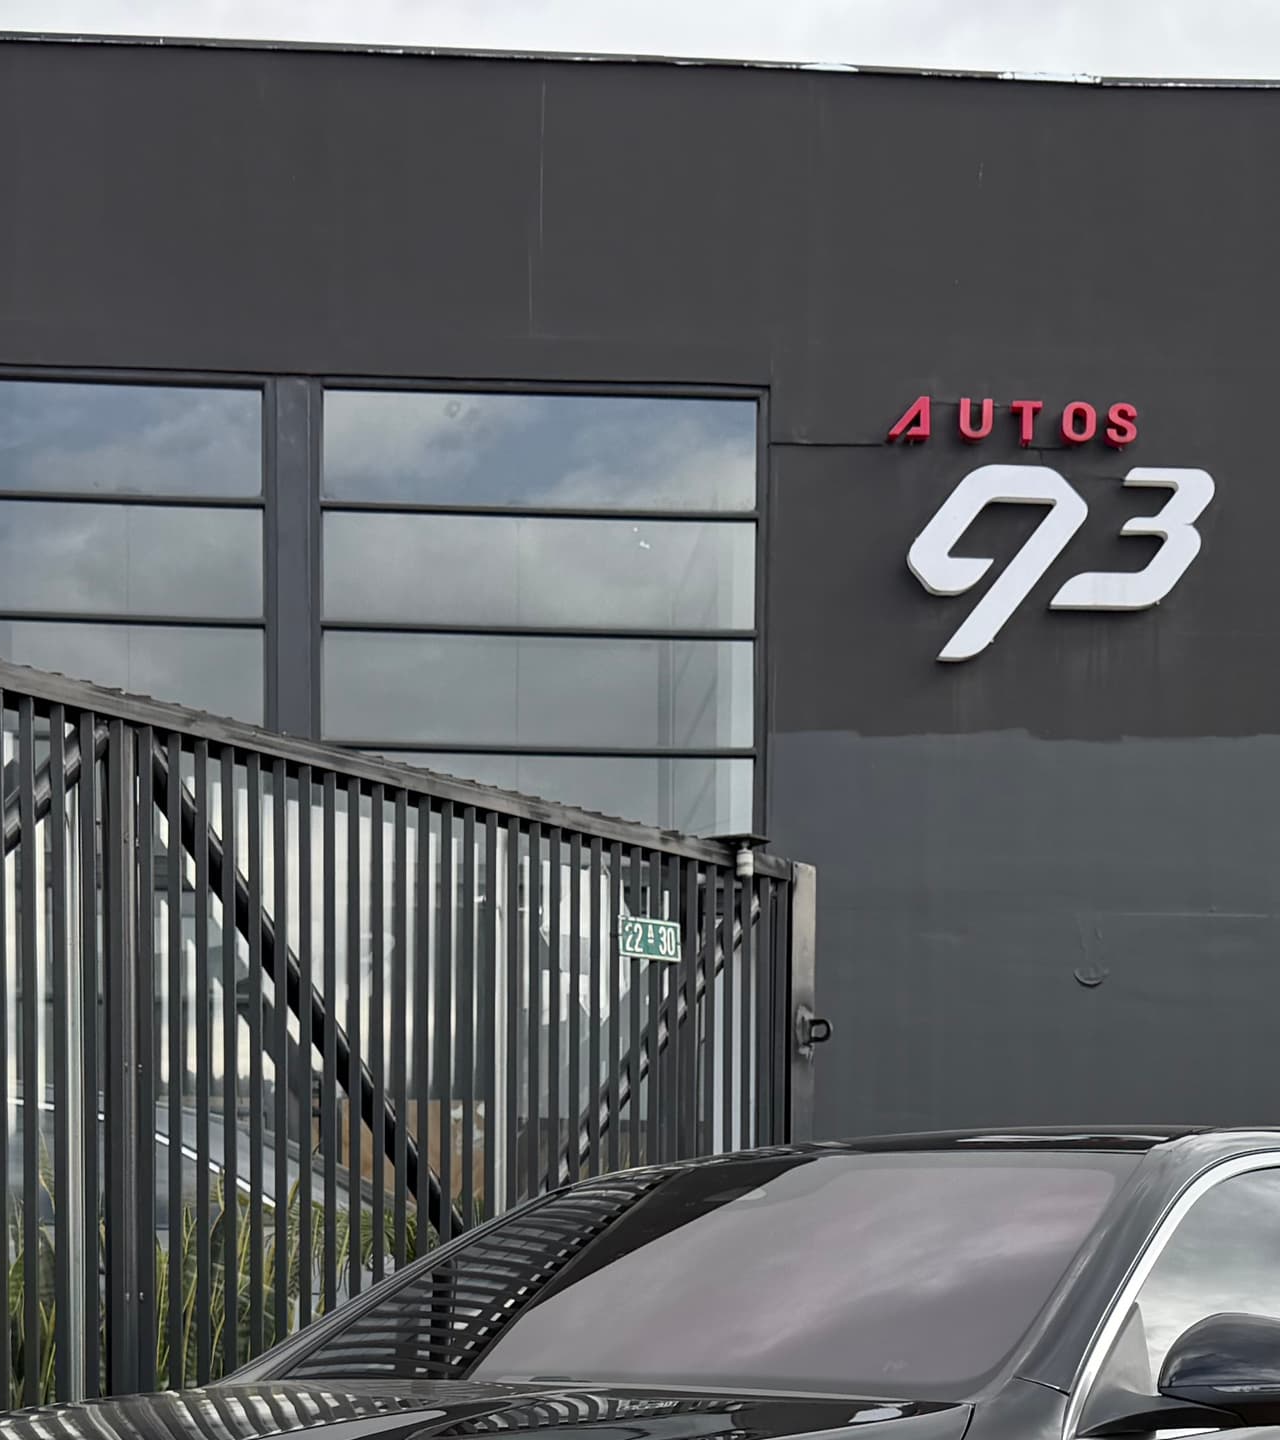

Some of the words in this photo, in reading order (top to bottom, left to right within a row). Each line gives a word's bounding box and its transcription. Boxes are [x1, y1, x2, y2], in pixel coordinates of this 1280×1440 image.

[886, 395, 1138, 448] AUTOS
[906, 464, 1216, 662] 93
[658, 926, 676, 956] 30
